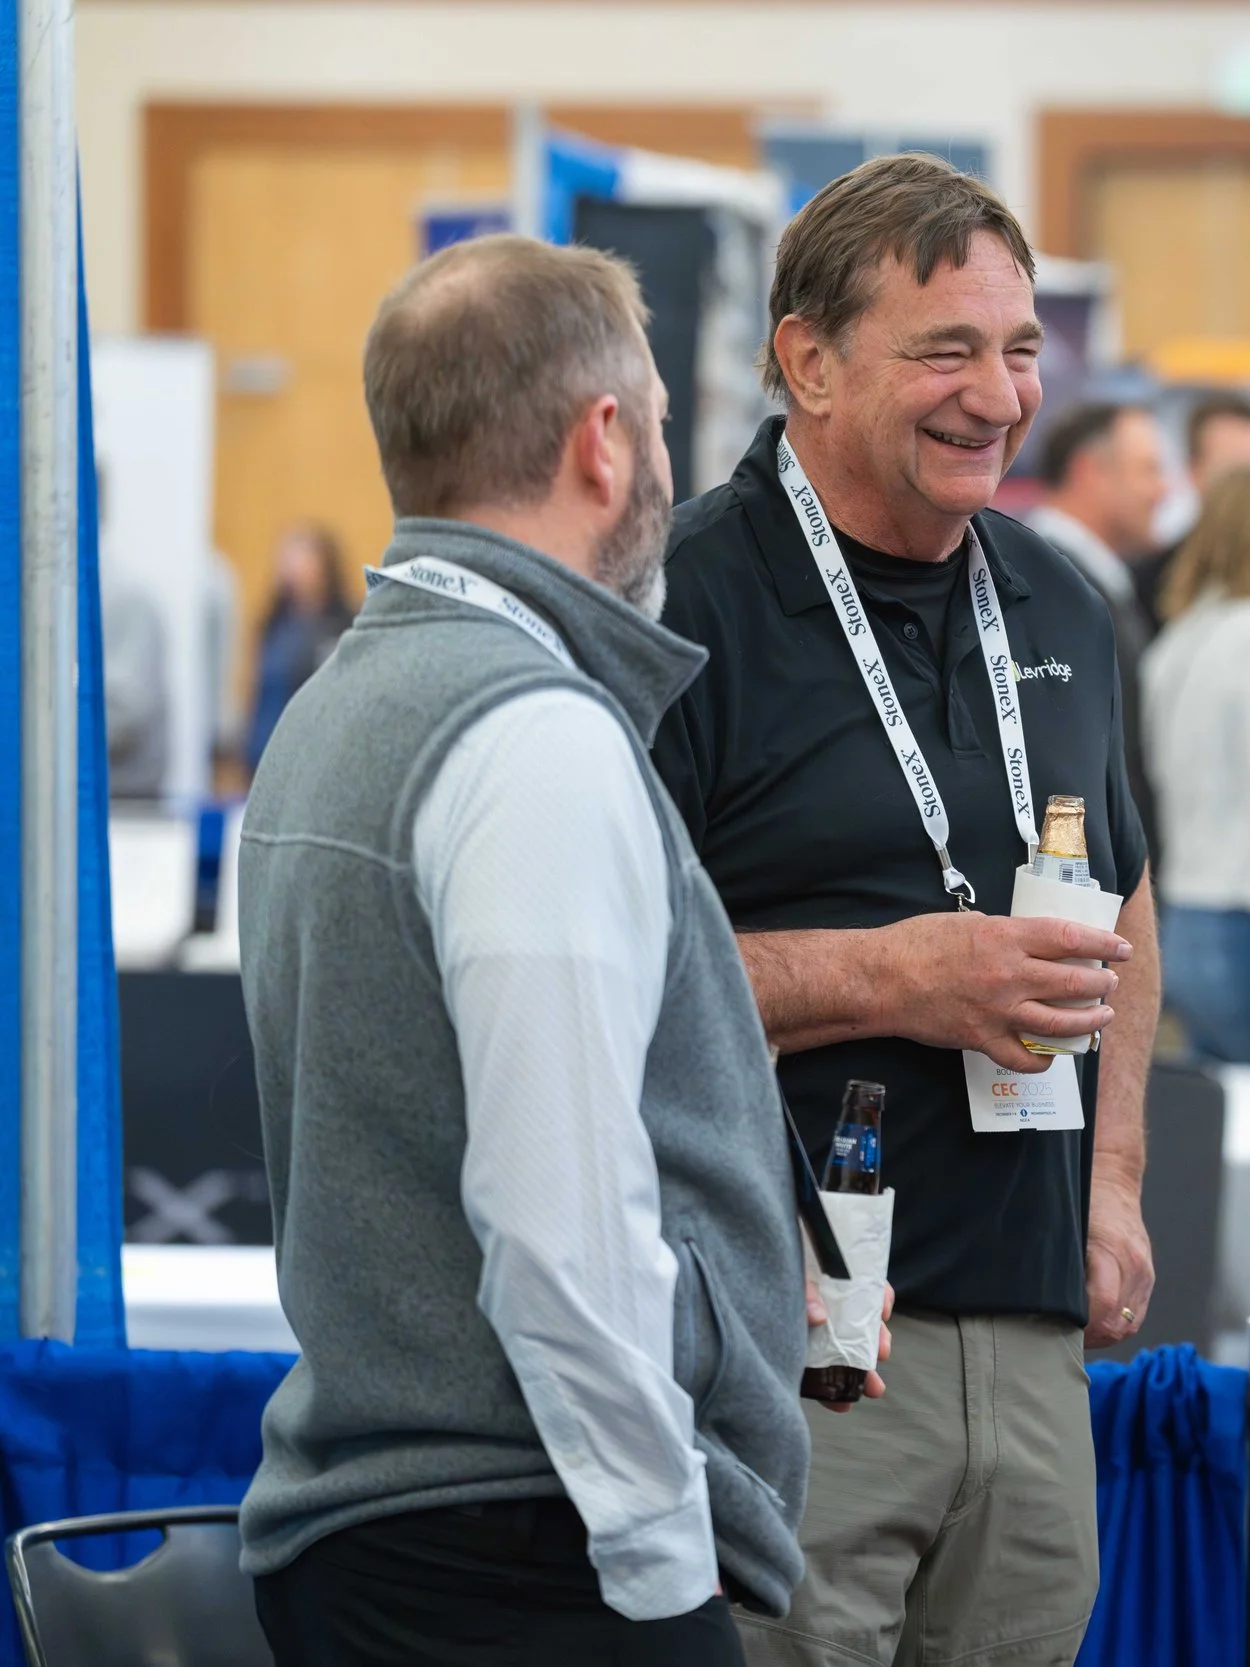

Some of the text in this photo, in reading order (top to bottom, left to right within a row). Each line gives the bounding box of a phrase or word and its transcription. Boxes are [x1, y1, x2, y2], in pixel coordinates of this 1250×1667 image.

[777, 440, 796, 474] Ston
[790, 485, 830, 548] StoneX
[406, 564, 478, 596] StoneX
[825, 568, 867, 636] StoneX
[973, 568, 1000, 632] StoneX
[862, 658, 903, 727] StoneX
[990, 654, 1017, 725] StoneX
[1018, 656, 1073, 682] Levridge
[900, 748, 941, 818] StoneX
[1007, 747, 1031, 819] StoneX
[991, 1082, 1053, 1097] CEC 2025
